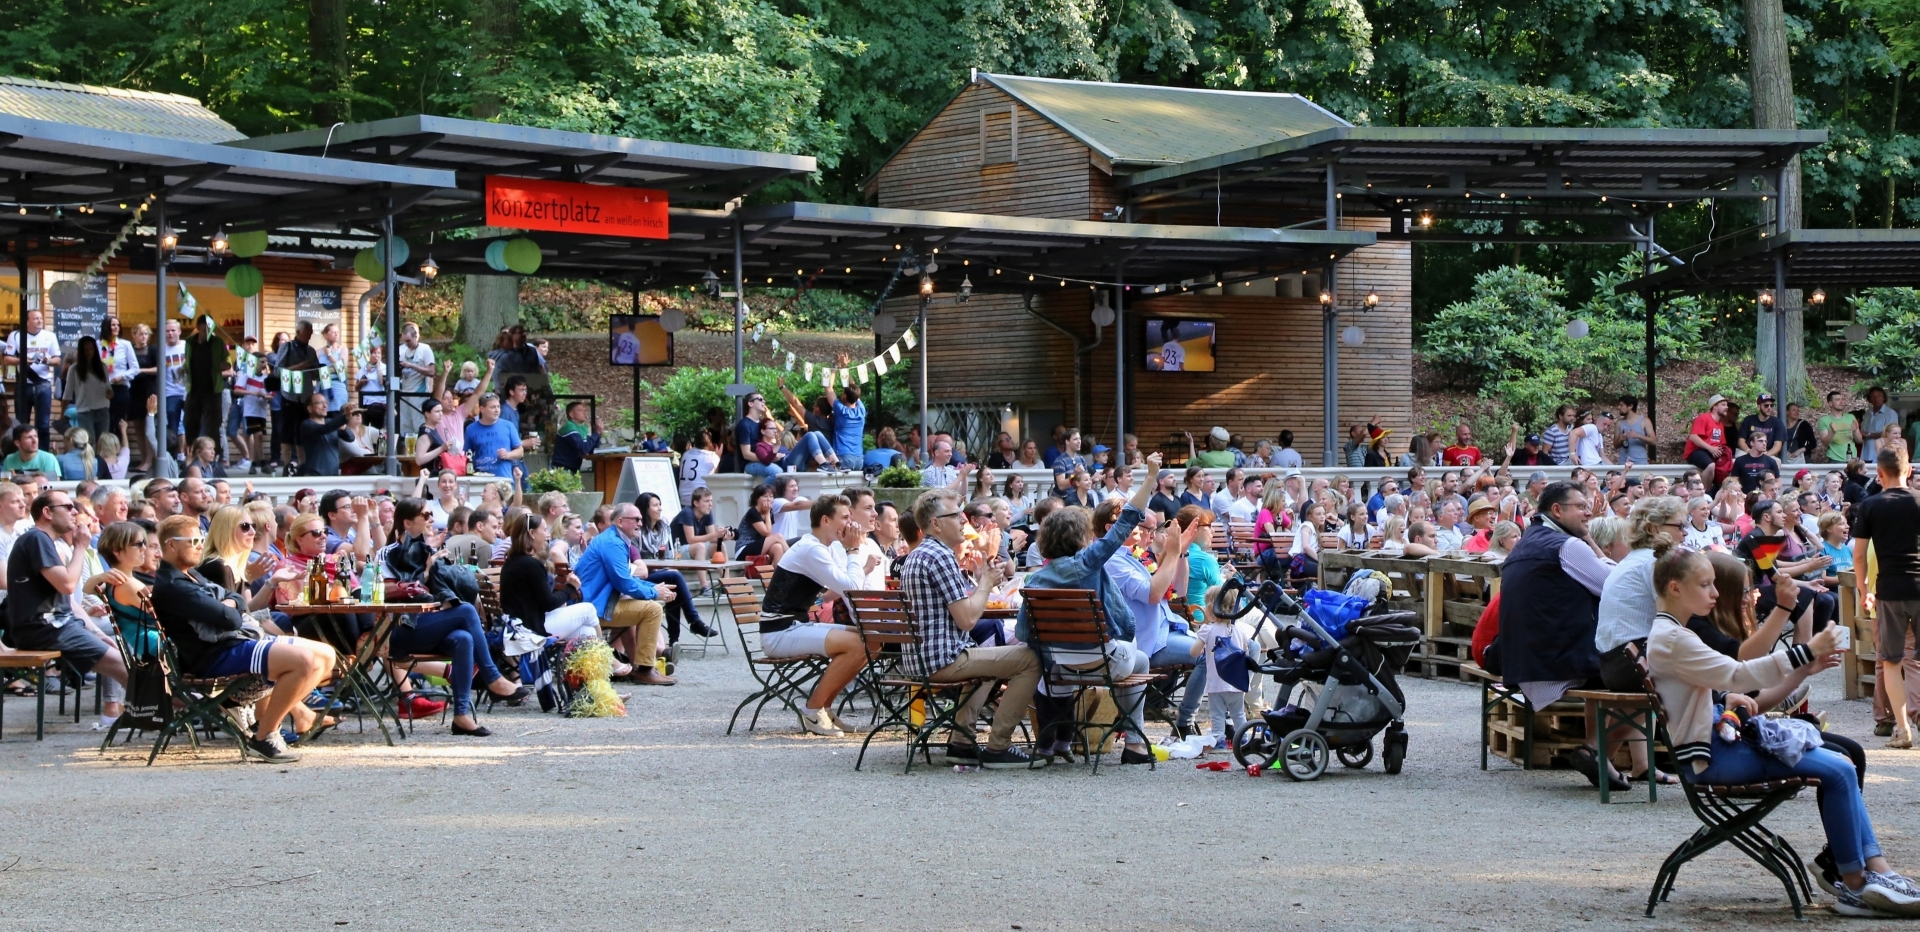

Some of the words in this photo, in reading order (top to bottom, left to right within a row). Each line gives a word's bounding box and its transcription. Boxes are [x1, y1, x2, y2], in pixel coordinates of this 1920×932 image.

[492, 190, 601, 227] konzertplatz
[604, 216, 615, 225] am
[616, 214, 642, 227] weißen
[642, 216, 664, 229] hirsch
[621, 340, 633, 355] 23
[1165, 349, 1177, 365] 23
[680, 458, 699, 481] 13
